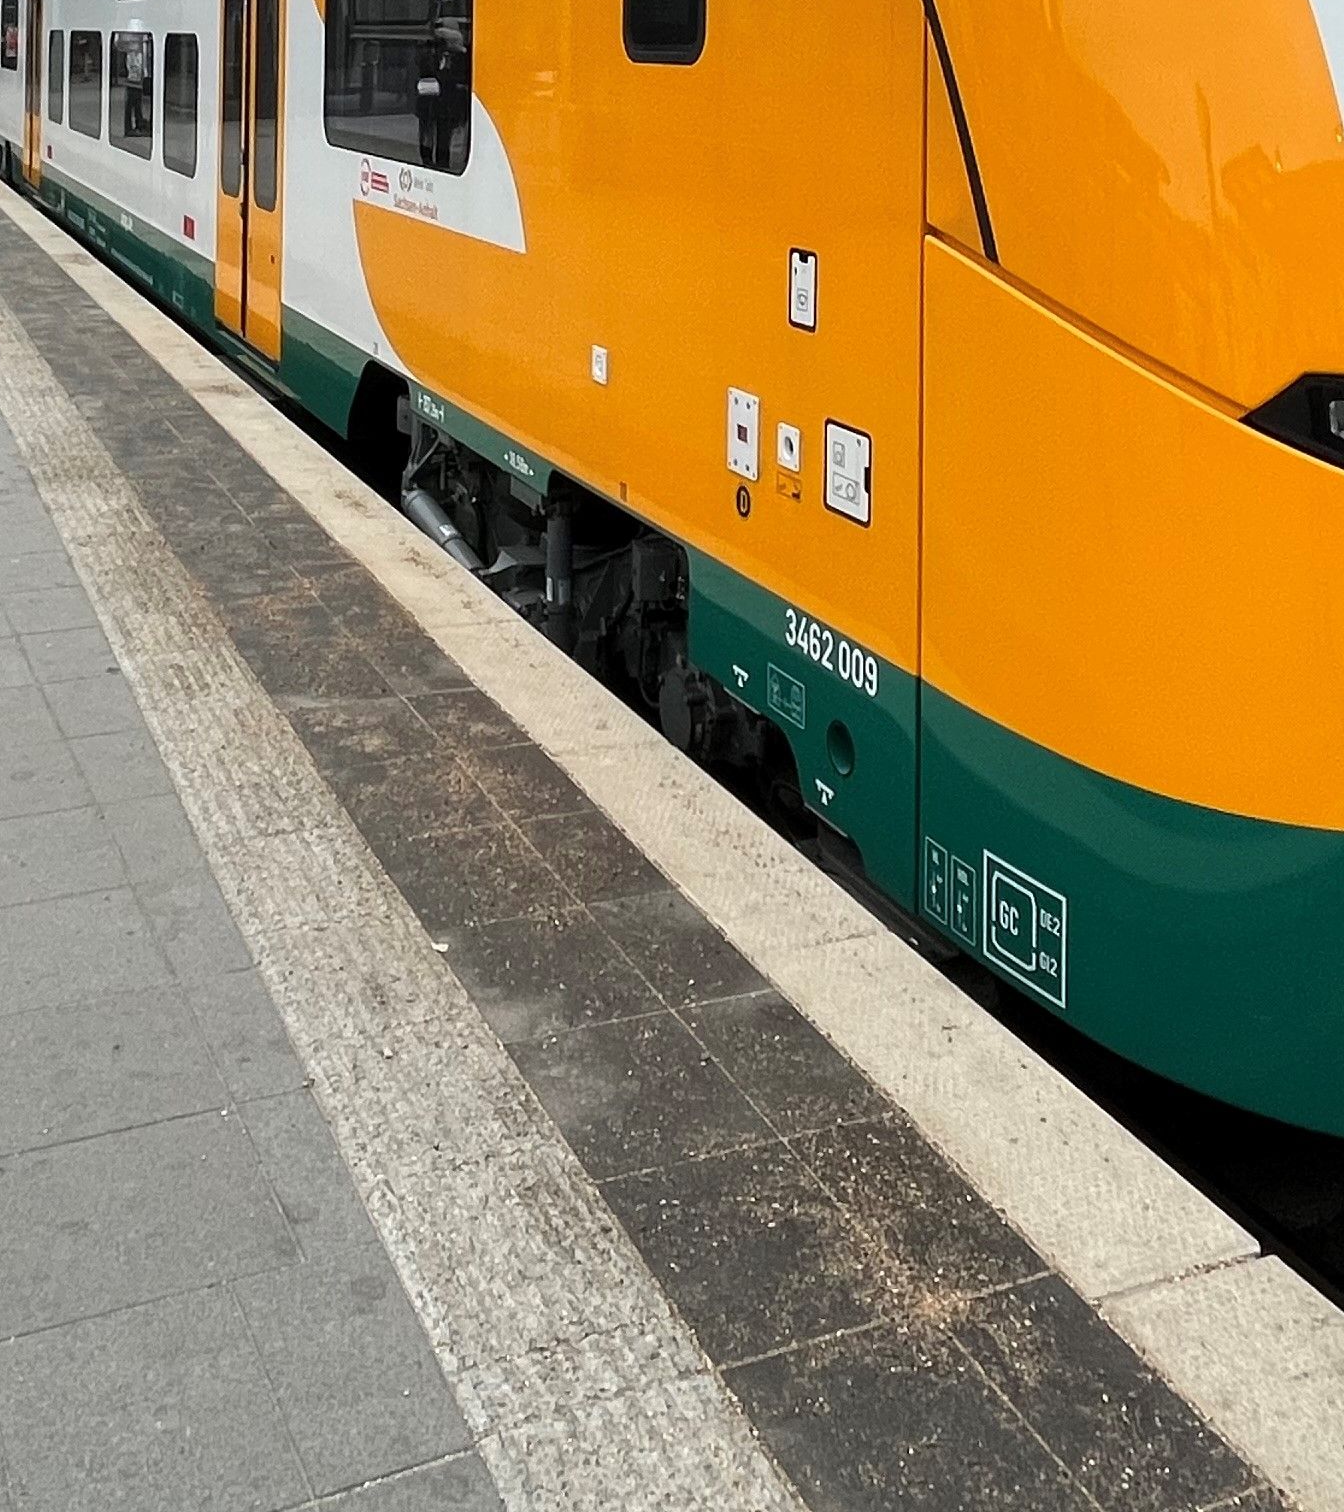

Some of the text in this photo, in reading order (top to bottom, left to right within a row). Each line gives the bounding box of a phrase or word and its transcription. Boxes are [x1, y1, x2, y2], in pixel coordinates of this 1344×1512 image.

[785, 608, 878, 697] 3462 009
[999, 900, 1019, 936] GC
